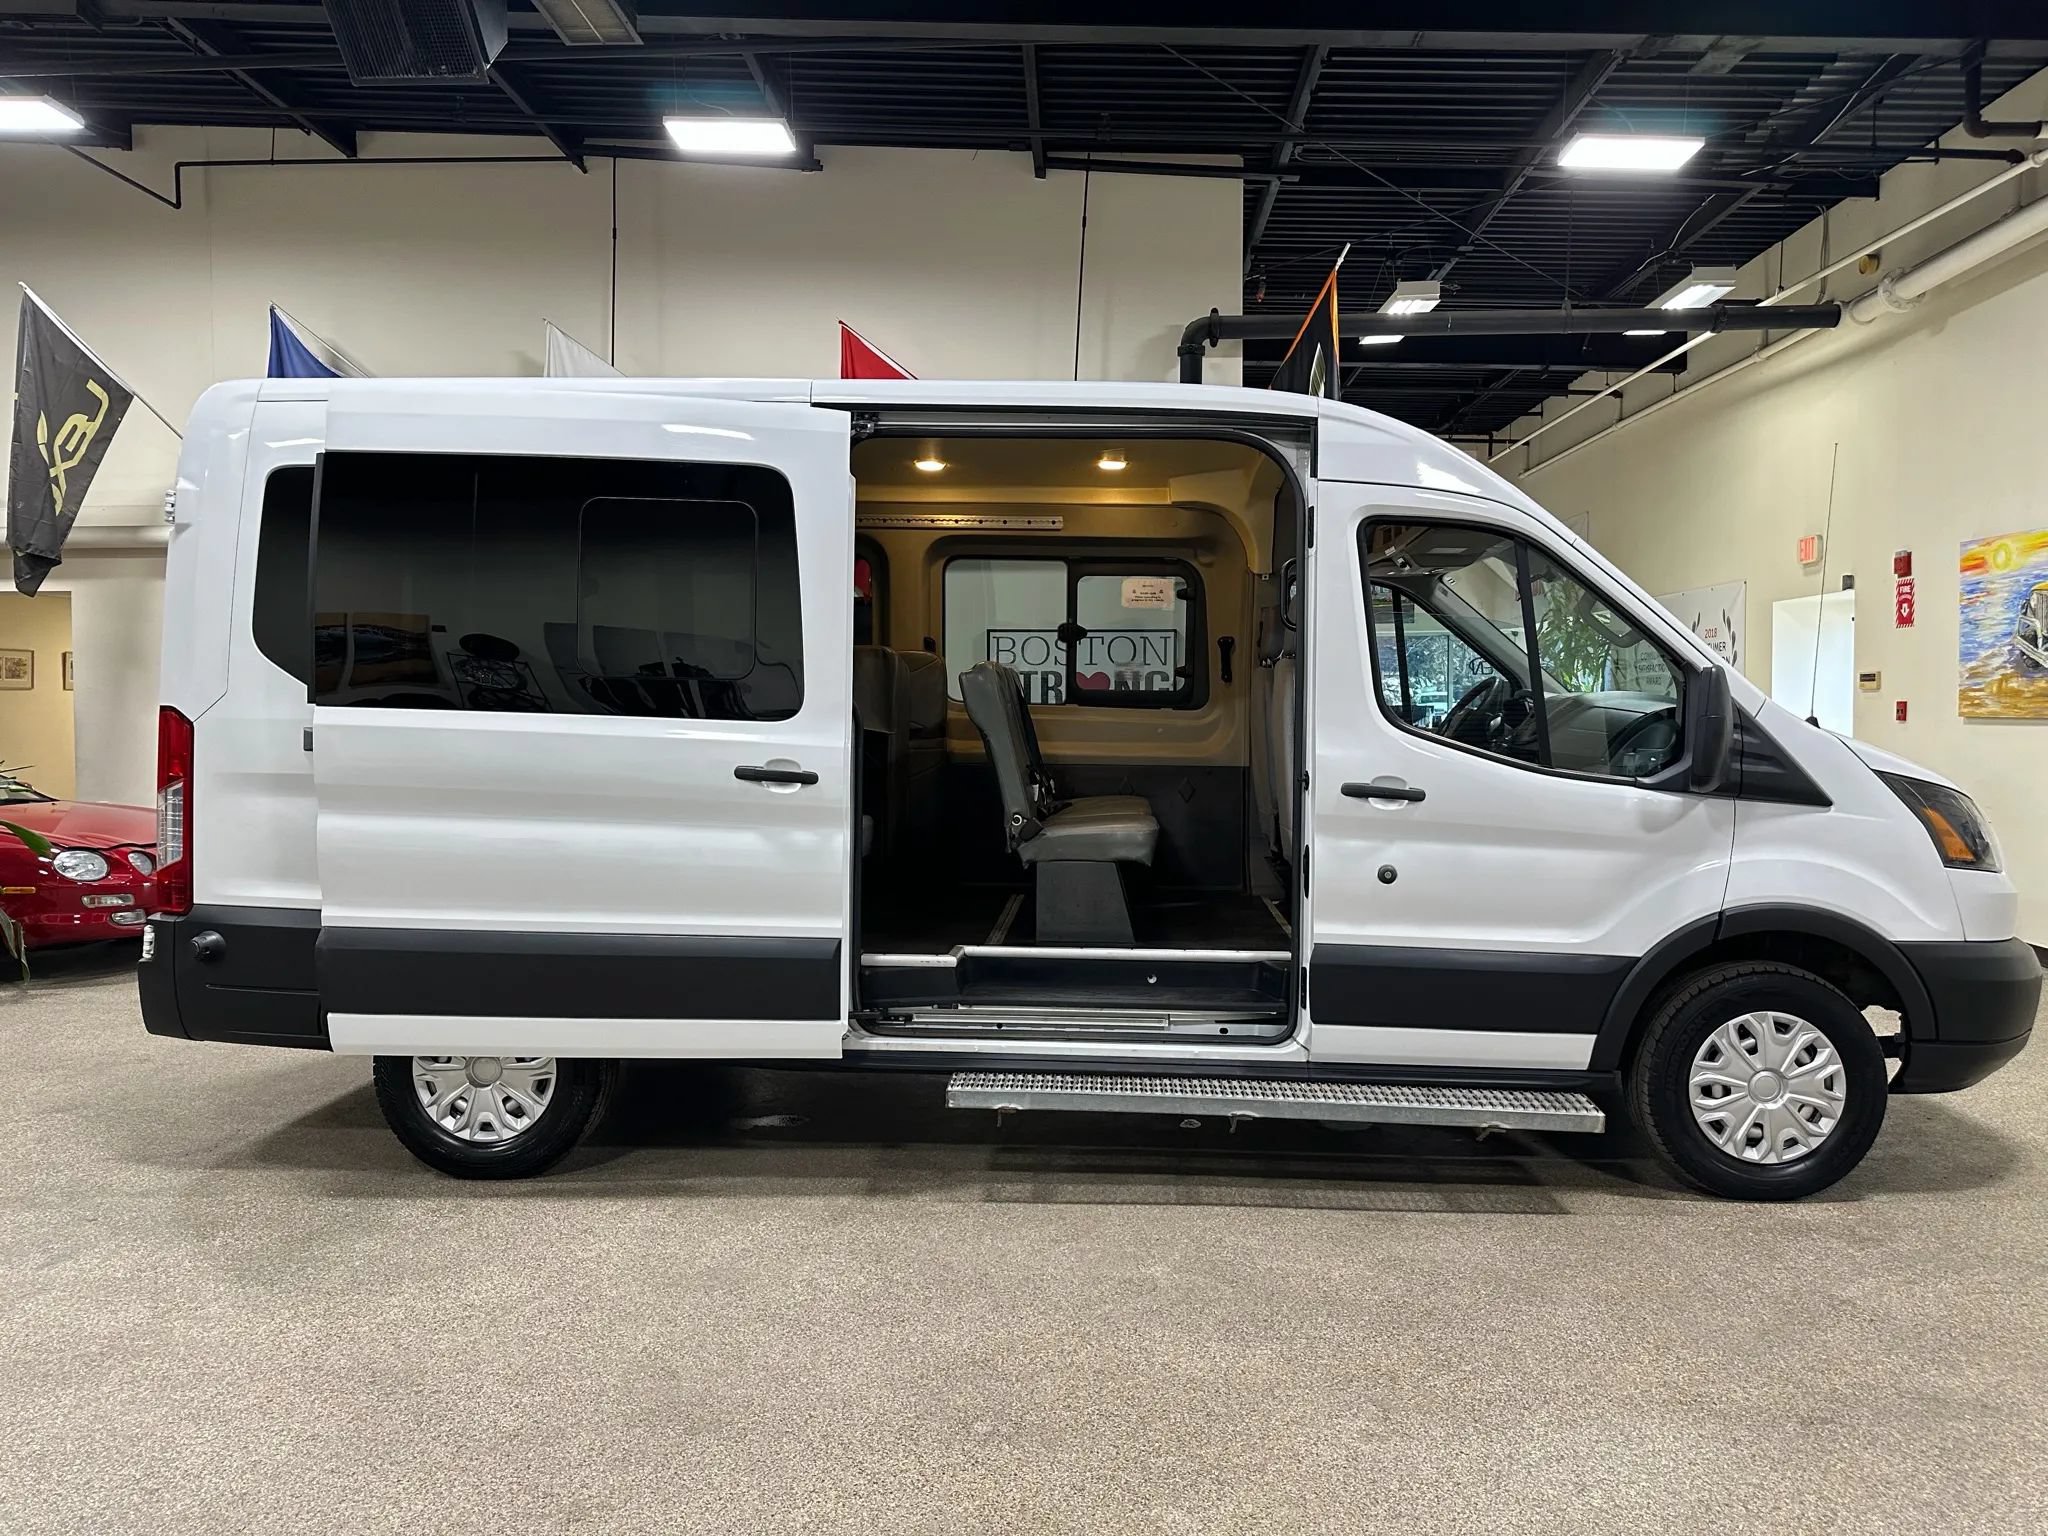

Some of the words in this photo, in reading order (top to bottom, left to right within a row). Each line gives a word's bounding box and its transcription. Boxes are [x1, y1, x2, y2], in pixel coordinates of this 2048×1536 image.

[1799, 536, 1816, 562] EXIT
[1704, 627, 1718, 639] 2018
[992, 635, 1172, 667] BOSTON
